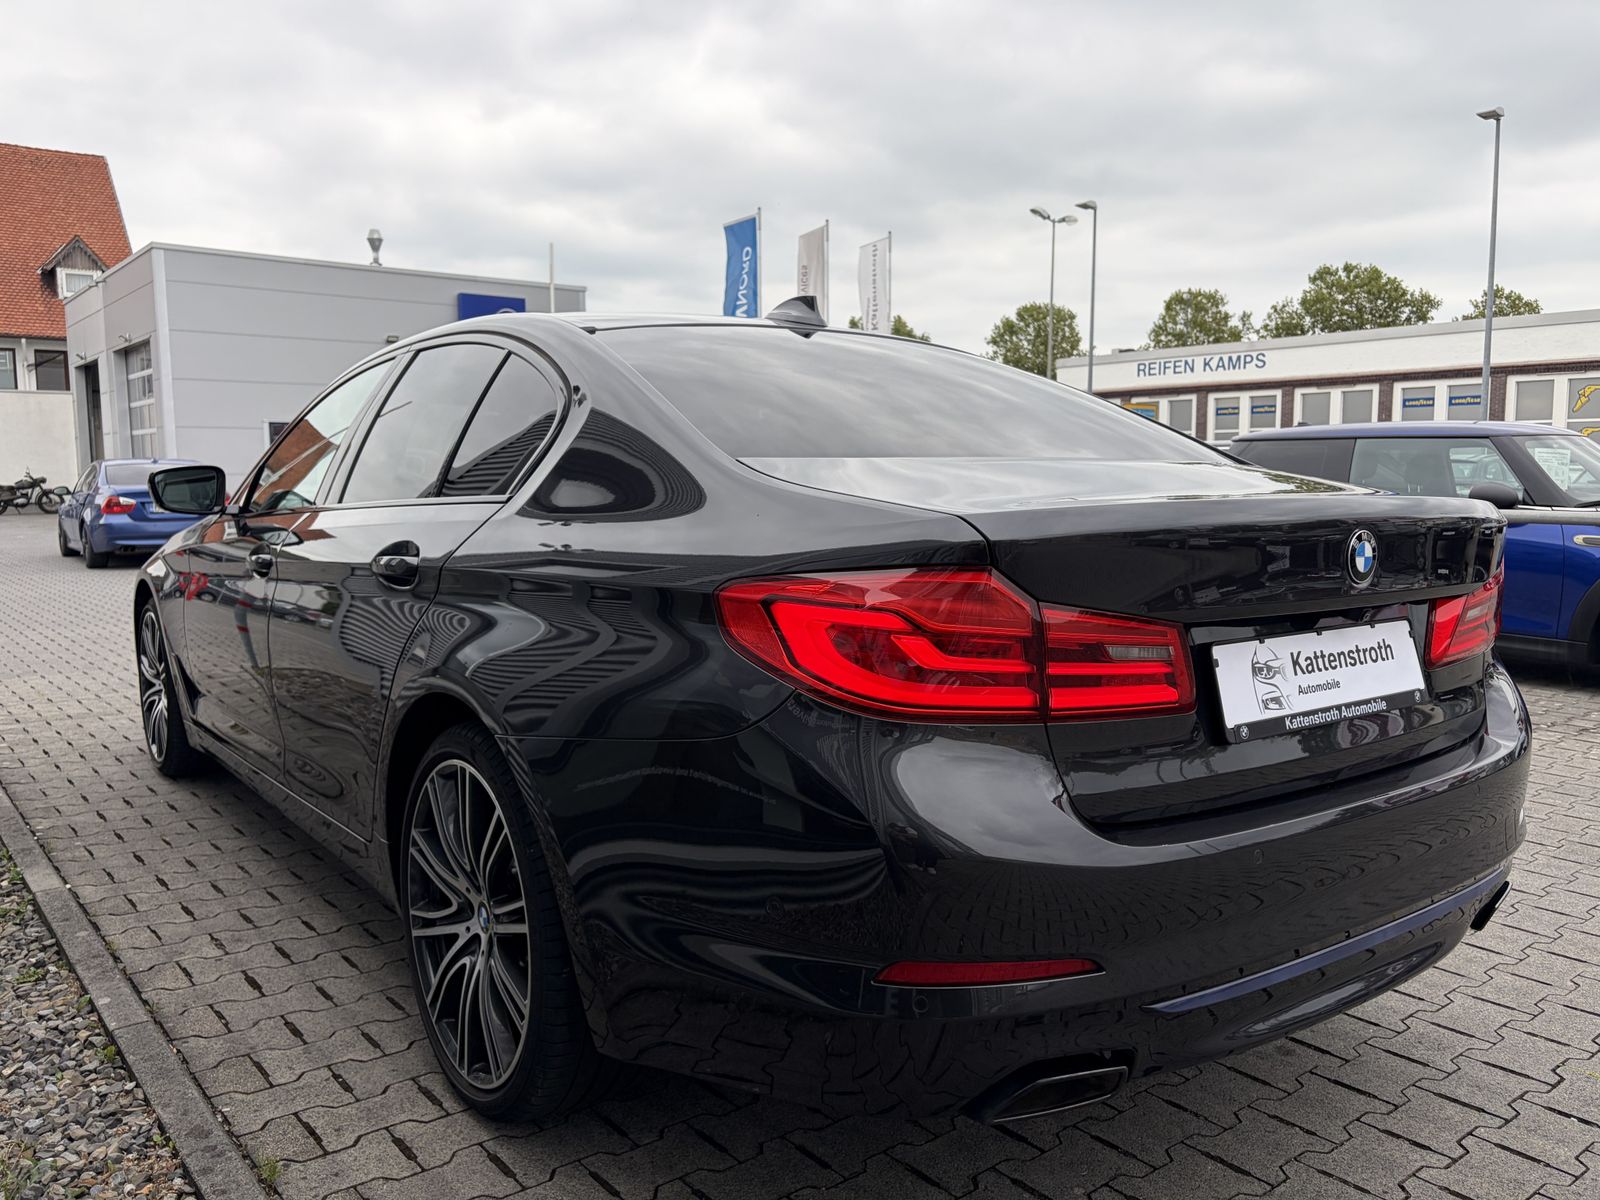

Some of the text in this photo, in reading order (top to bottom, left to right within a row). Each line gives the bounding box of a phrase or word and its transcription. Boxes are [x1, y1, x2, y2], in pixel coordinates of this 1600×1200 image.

[1137, 352, 1267, 377] REIFEN KAMPS
[1289, 638, 1395, 677] Kattenstroth
[1297, 679, 1341, 696] Automobile
[1285, 698, 1387, 730] Kattenstroth Automobile
